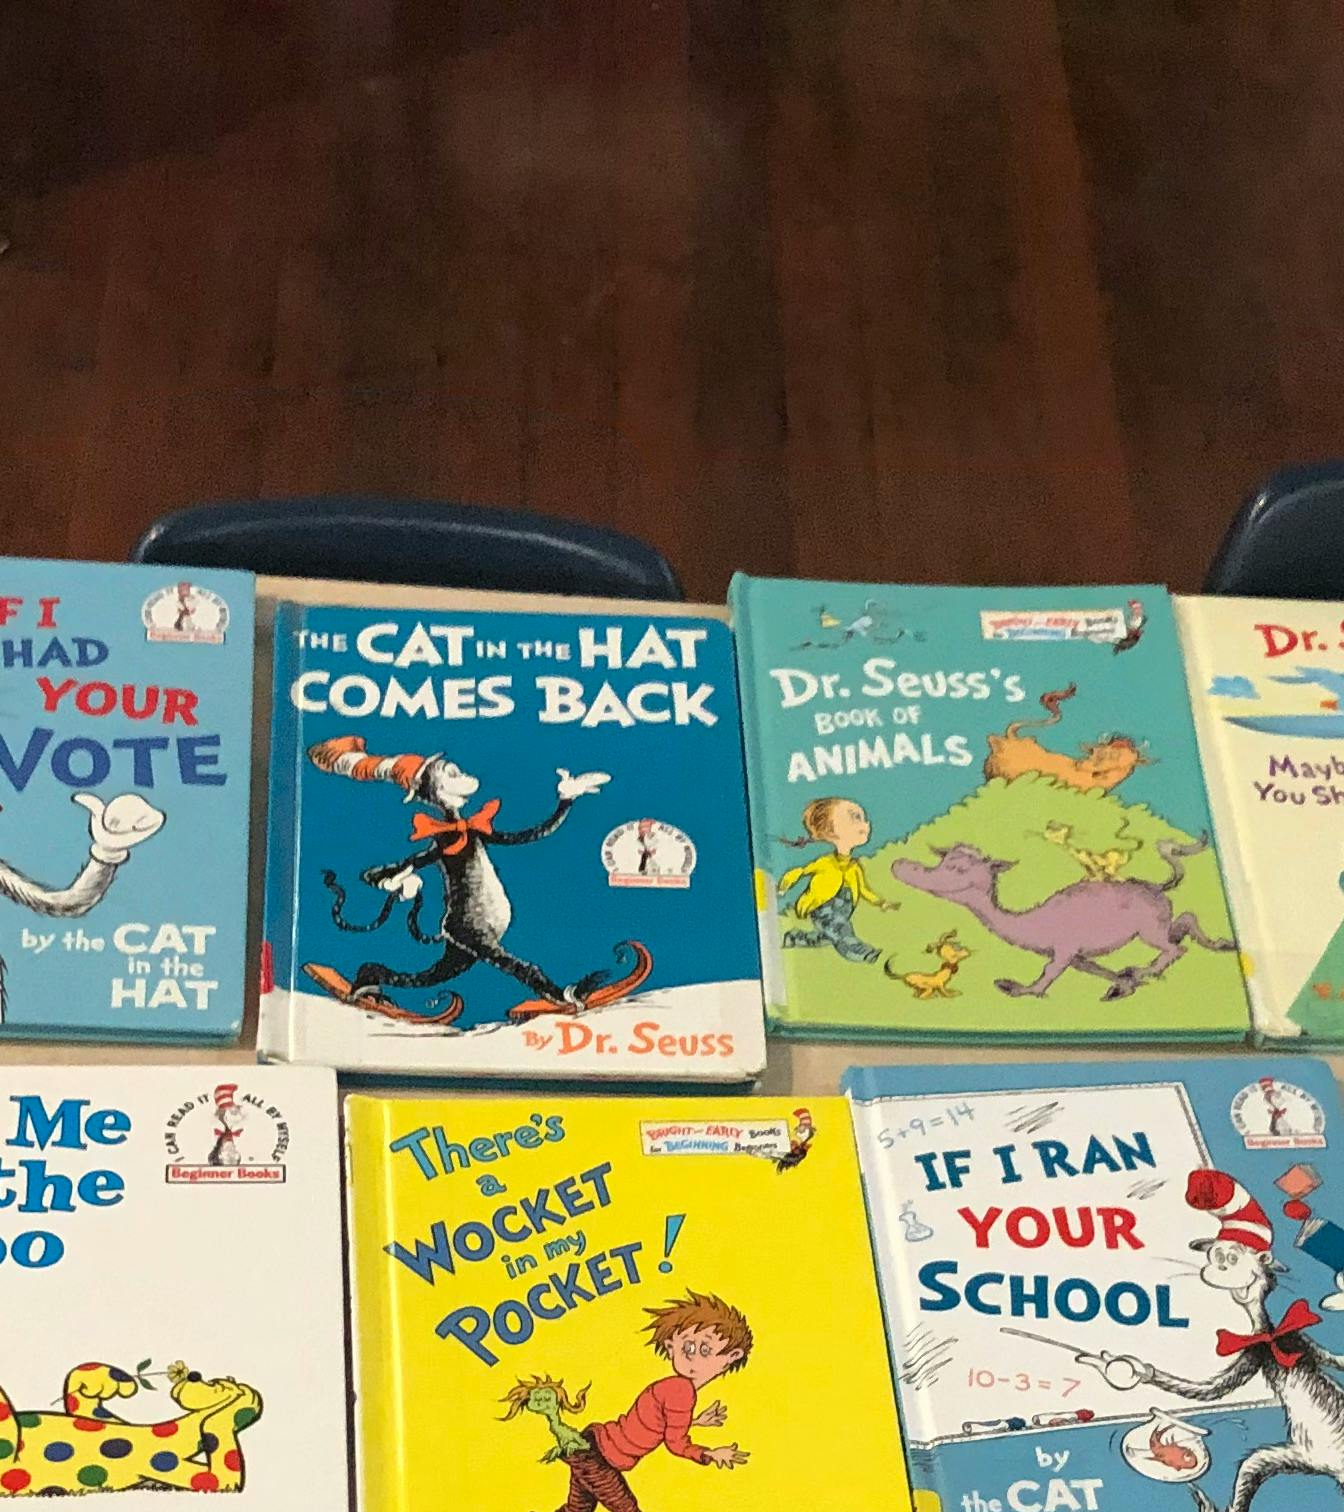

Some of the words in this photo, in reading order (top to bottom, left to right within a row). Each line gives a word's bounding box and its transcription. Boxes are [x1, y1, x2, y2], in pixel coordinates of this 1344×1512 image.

[37, 597, 60, 627] I
[1, 638, 109, 669] HAD
[293, 629, 348, 653] THE
[357, 621, 475, 669] CAT
[476, 640, 507, 659] IN
[516, 642, 571, 660] THE
[578, 624, 709, 669] HAT
[1254, 623, 1329, 660] Dr.
[769, 667, 851, 708] Dr.
[861, 656, 1027, 703] Seuss's
[36, 676, 199, 725] YOUR
[290, 671, 515, 719] COMES
[535, 675, 719, 728] BACK
[814, 707, 883, 736] BOOK
[892, 705, 922, 726] OF
[786, 732, 974, 783] ANIMALS
[1254, 780, 1307, 807] You
[21, 929, 55, 953] by
[62, 928, 104, 951] the
[113, 923, 216, 955] CAT
[128, 956, 150, 976] in
[160, 956, 204, 977] the
[111, 978, 218, 1010] HAT
[167, 1101, 194, 1127] READ
[197, 1094, 210, 1104] IT
[242, 1094, 264, 1108] ALL
[265, 1106, 282, 1119] BY
[6, 1094, 133, 1151] Me
[165, 1132, 179, 1154] CAN
[388, 1113, 567, 1183] There's
[172, 1167, 234, 1182] Beginner
[237, 1168, 280, 1178] Books
[914, 1148, 971, 1192] IF
[998, 1143, 1023, 1184] I
[1031, 1131, 1158, 1179] RAN
[474, 1172, 506, 1196] a
[382, 1161, 613, 1287] WOCKET
[956, 1206, 1145, 1251] YOUR
[500, 1252, 537, 1280] in
[542, 1228, 587, 1263] my
[435, 1213, 687, 1367] POCKET!
[917, 1259, 1190, 1329] SCHOOL
